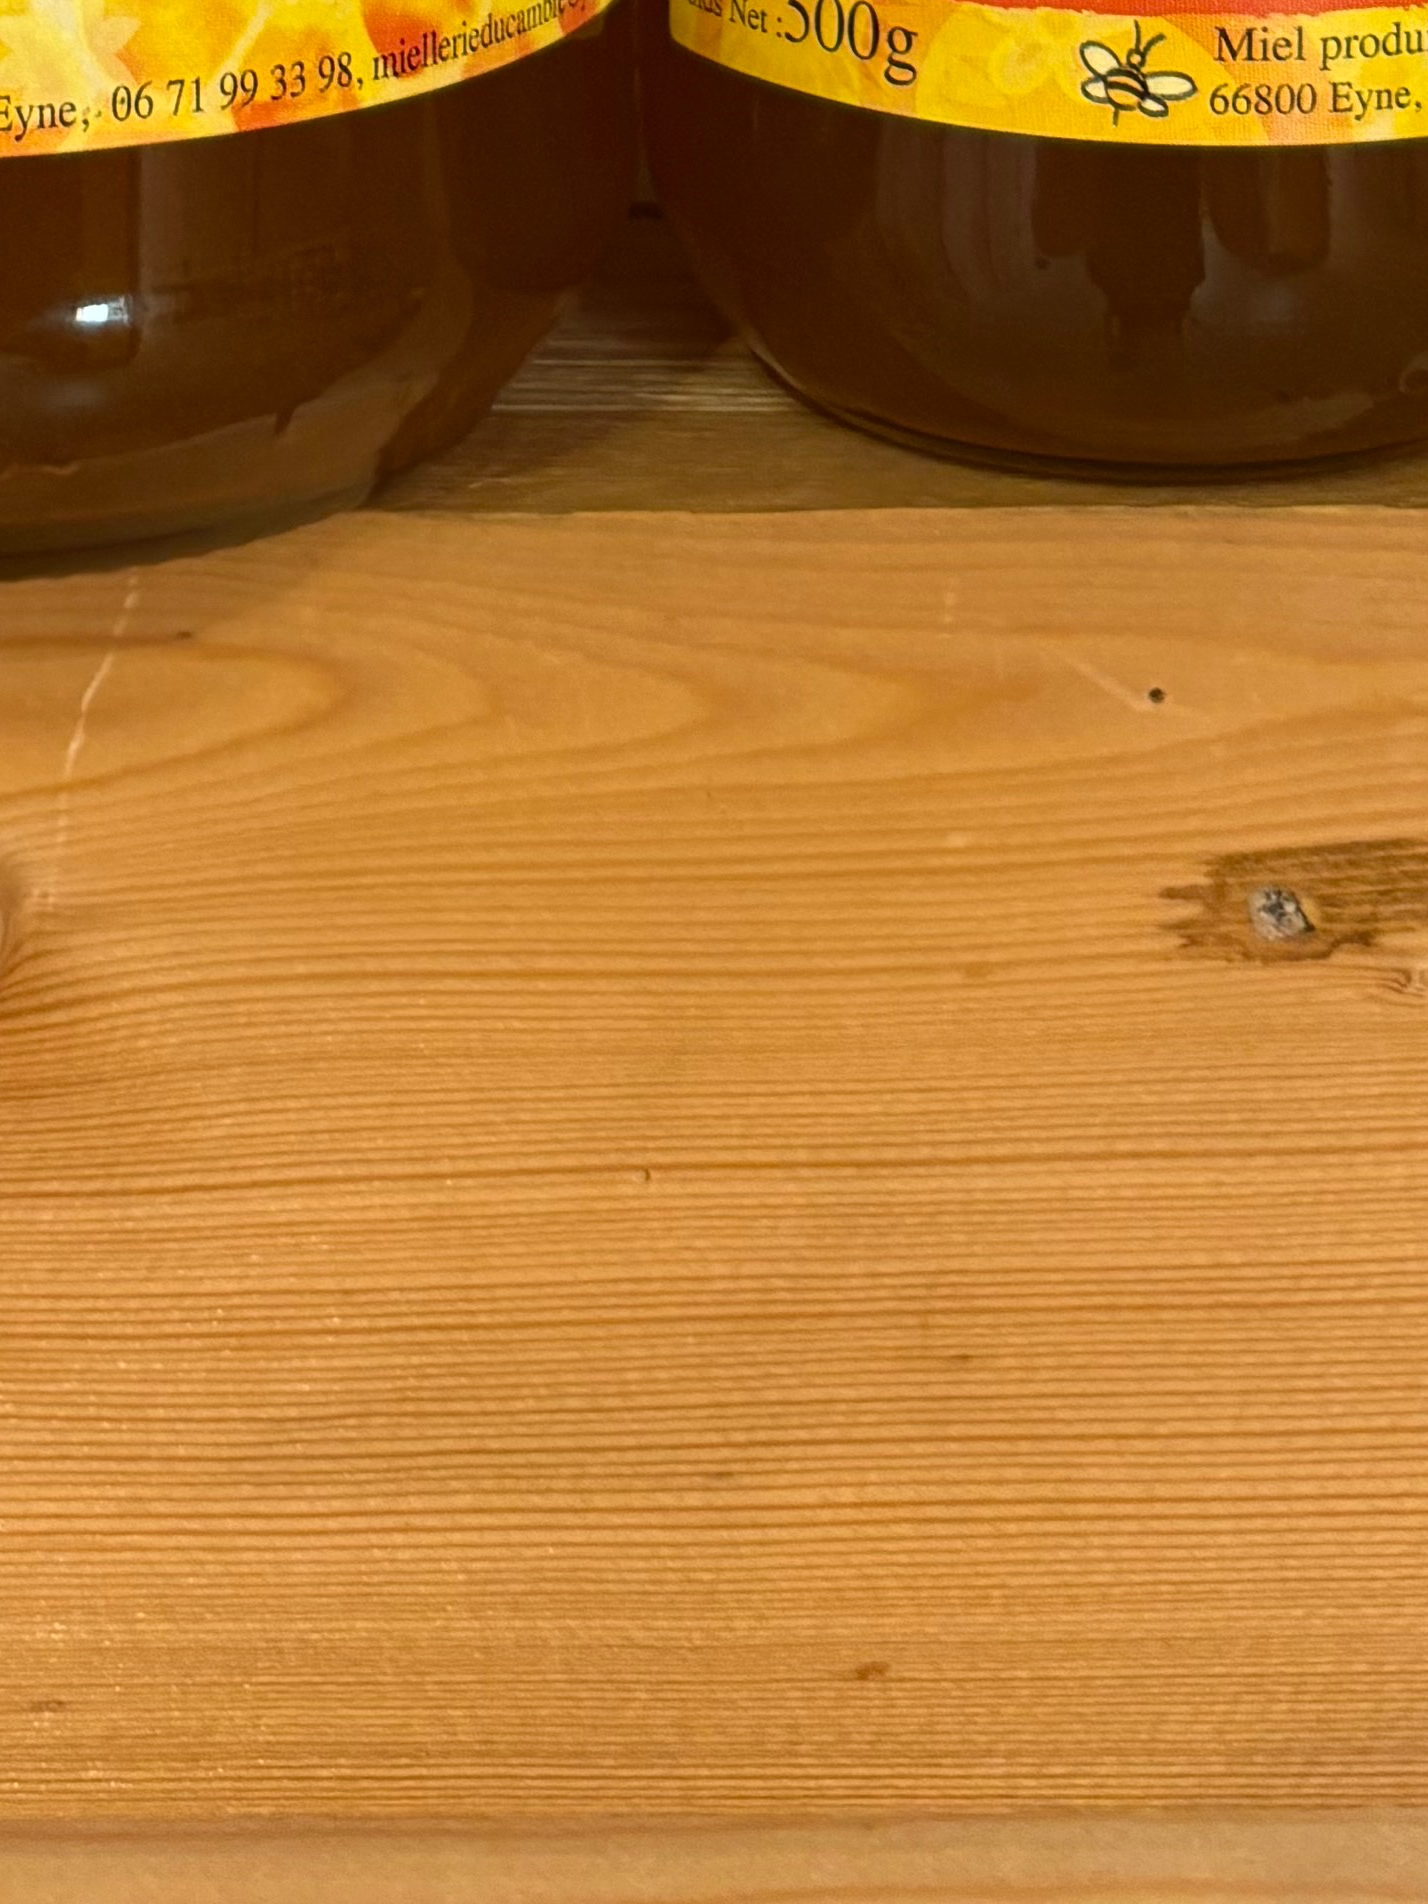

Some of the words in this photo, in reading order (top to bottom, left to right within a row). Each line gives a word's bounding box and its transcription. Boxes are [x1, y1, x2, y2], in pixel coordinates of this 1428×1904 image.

[1214, 25, 1305, 63] Miel
[111, 81, 154, 122] 06
[170, 76, 204, 116] 71
[219, 68, 259, 111] 99
[270, 59, 306, 103] 33
[317, 51, 364, 92] 98,
[1208, 80, 1318, 116] 66800
[1327, 78, 1422, 120] Eyne,
